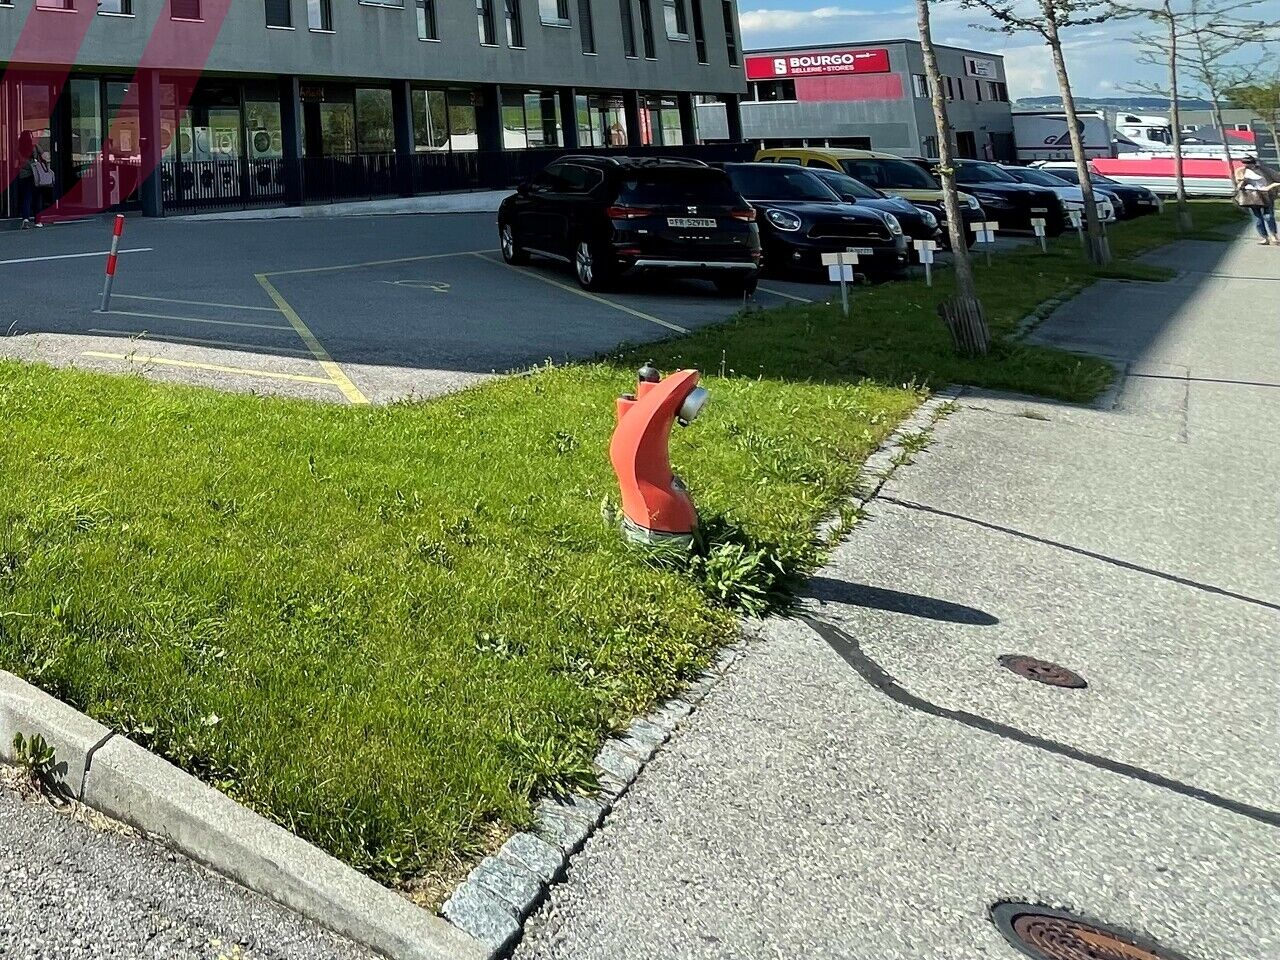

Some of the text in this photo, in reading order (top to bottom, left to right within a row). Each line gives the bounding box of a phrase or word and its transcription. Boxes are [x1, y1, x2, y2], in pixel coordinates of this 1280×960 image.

[789, 54, 854, 67] BOURGO
[791, 64, 855, 74] SELLERIE STORES
